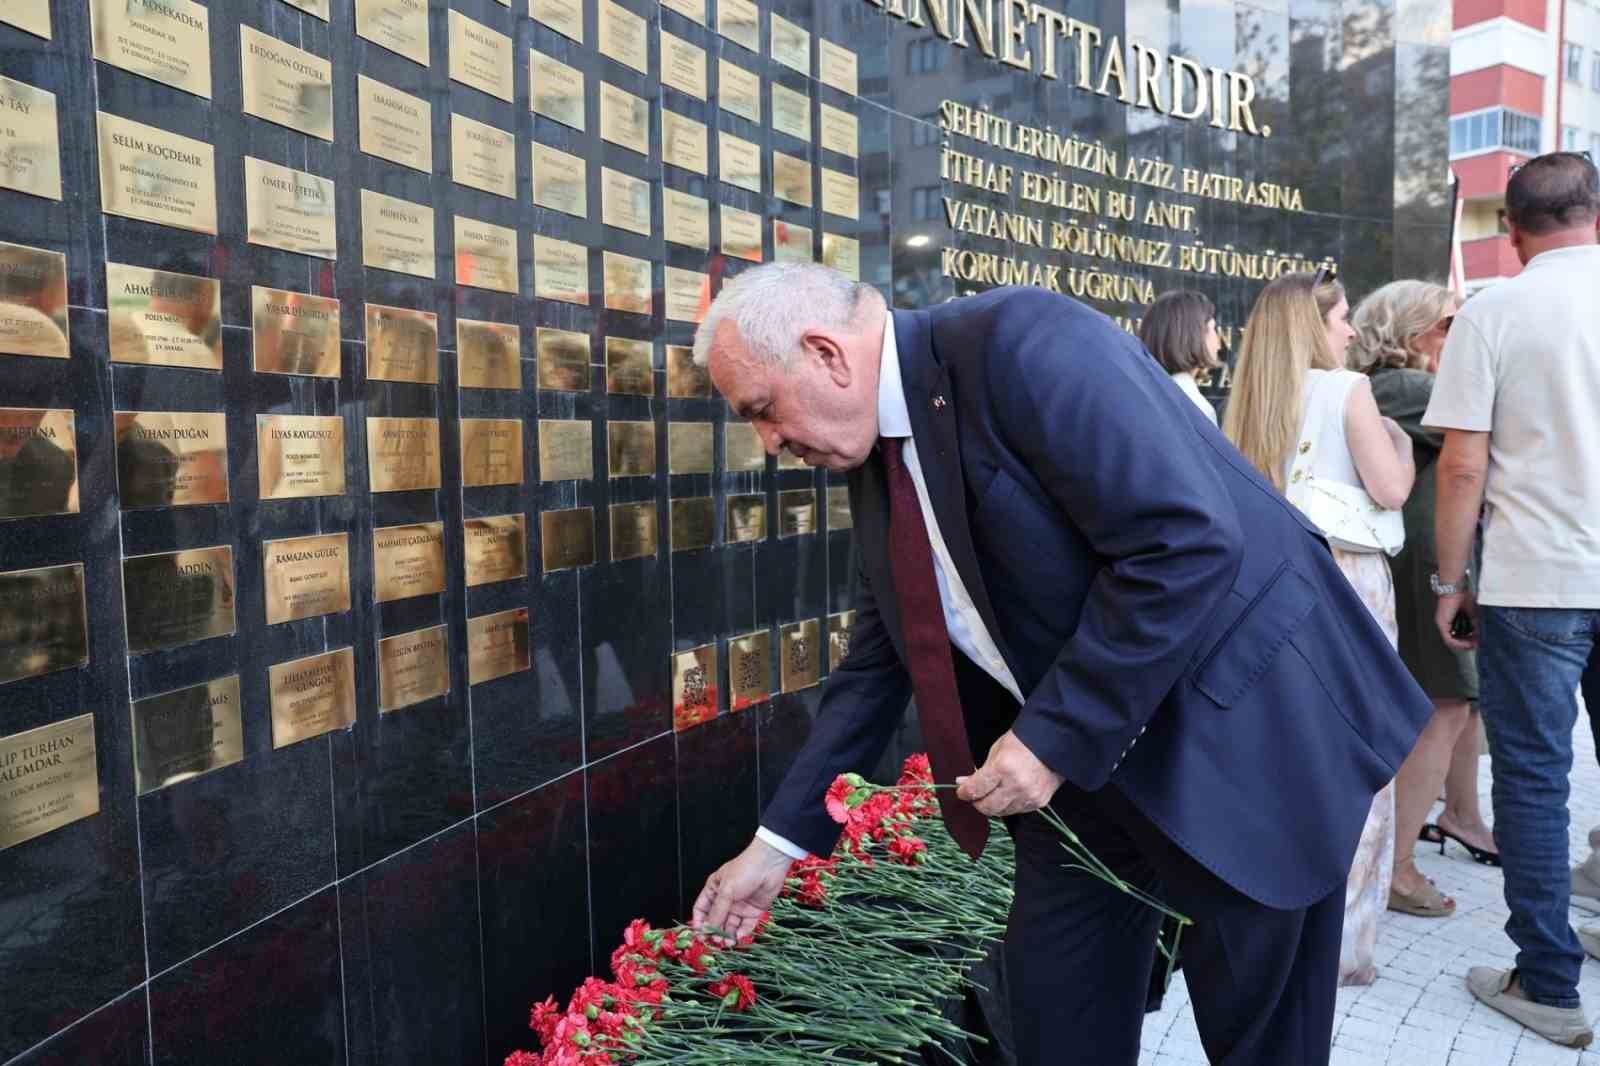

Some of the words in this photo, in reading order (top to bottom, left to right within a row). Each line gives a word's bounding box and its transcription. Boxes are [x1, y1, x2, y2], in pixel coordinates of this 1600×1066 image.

[112, 133, 145, 153] SELİM
[146, 142, 203, 168] KOÇDEMİR
[940, 100, 1118, 177] ŞEHİTLERİMİZİN
[1124, 155, 1177, 190] AZİZ
[1182, 167, 1304, 212] HATIRASINA
[940, 141, 1014, 195] İTHAF
[1021, 170, 1101, 215] EDİLEN
[1106, 189, 1137, 222] BU
[943, 196, 1044, 248] VATANIN
[1051, 218, 1173, 269] BÖLÜNMEZ
[942, 246, 1062, 293] KORUMAK
[1069, 265, 1157, 305] UĞRUNA
[21, 734, 75, 761] TURHAN
